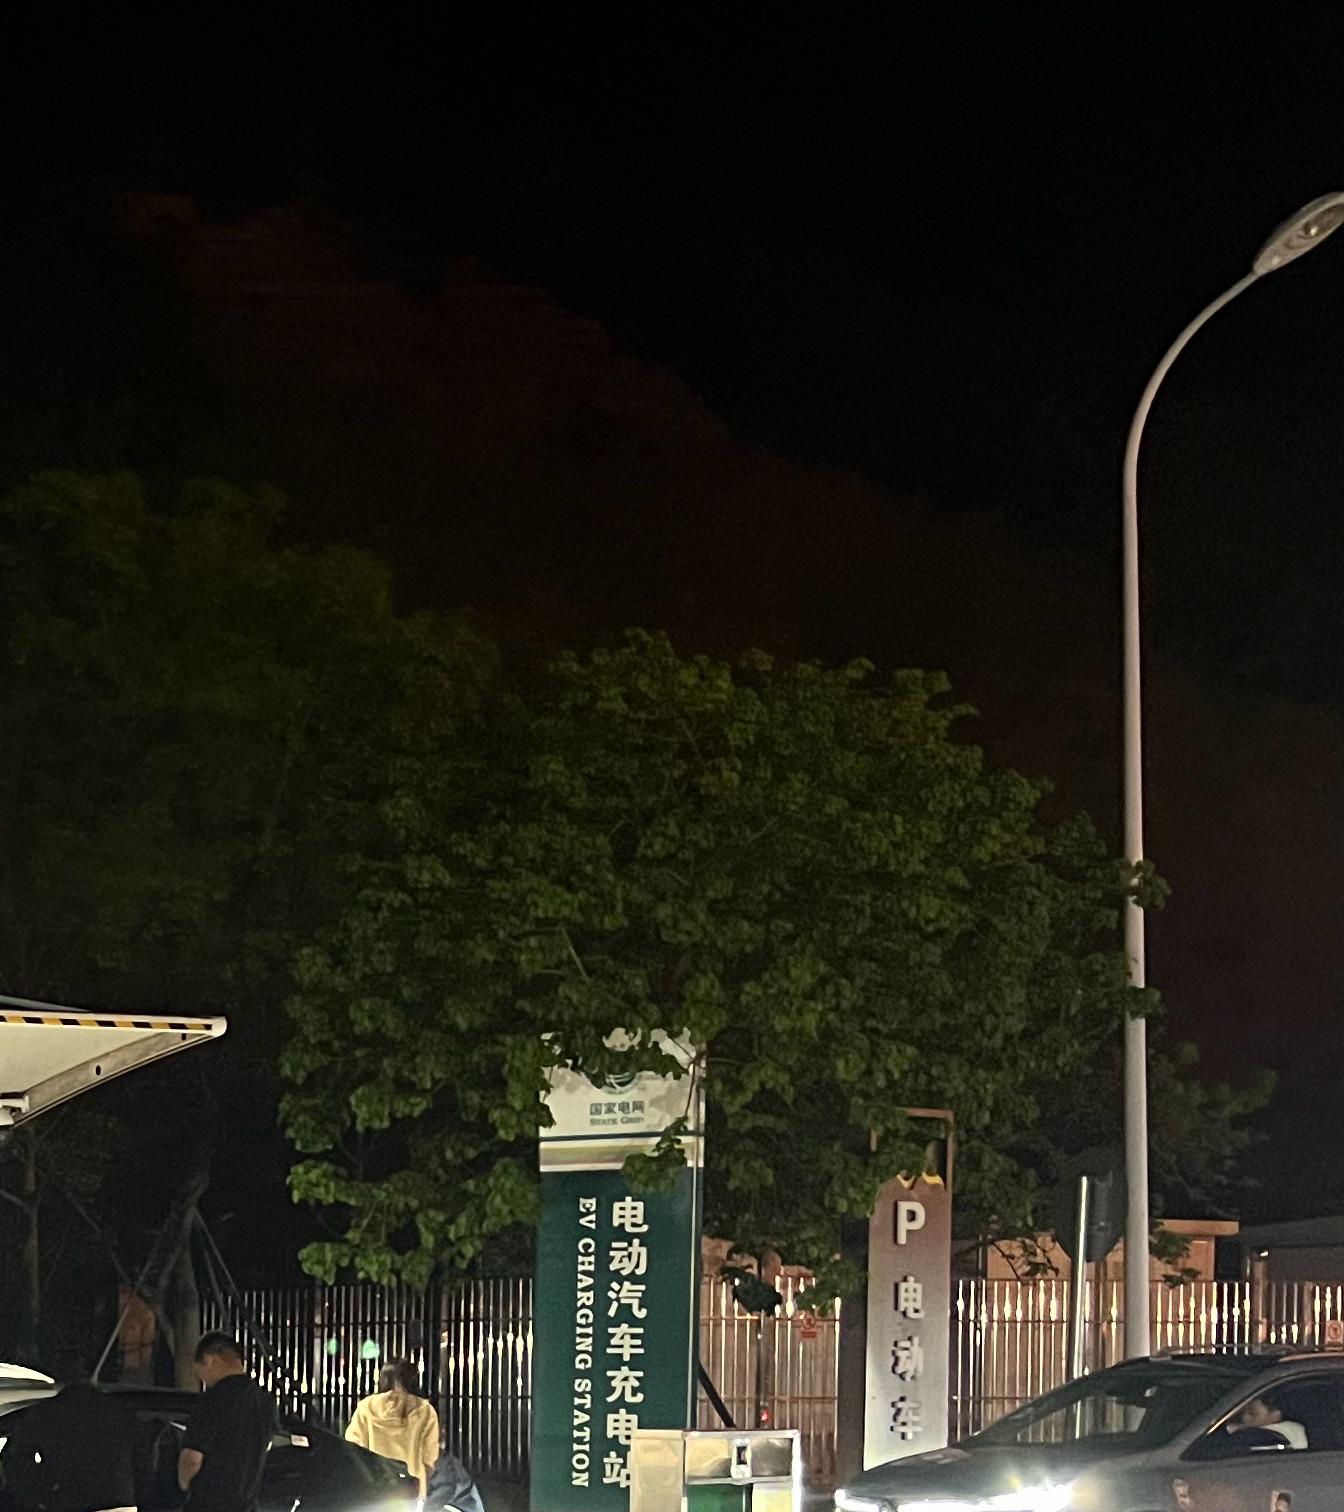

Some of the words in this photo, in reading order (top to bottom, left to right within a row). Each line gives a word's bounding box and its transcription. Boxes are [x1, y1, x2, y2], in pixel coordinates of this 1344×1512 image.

[579, 1197, 596, 1229] EV
[896, 1200, 925, 1245] P
[575, 1237, 595, 1370] CHARGING
[603, 1196, 649, 1488] 电动汽车充电站
[572, 1378, 591, 1487] STATION
